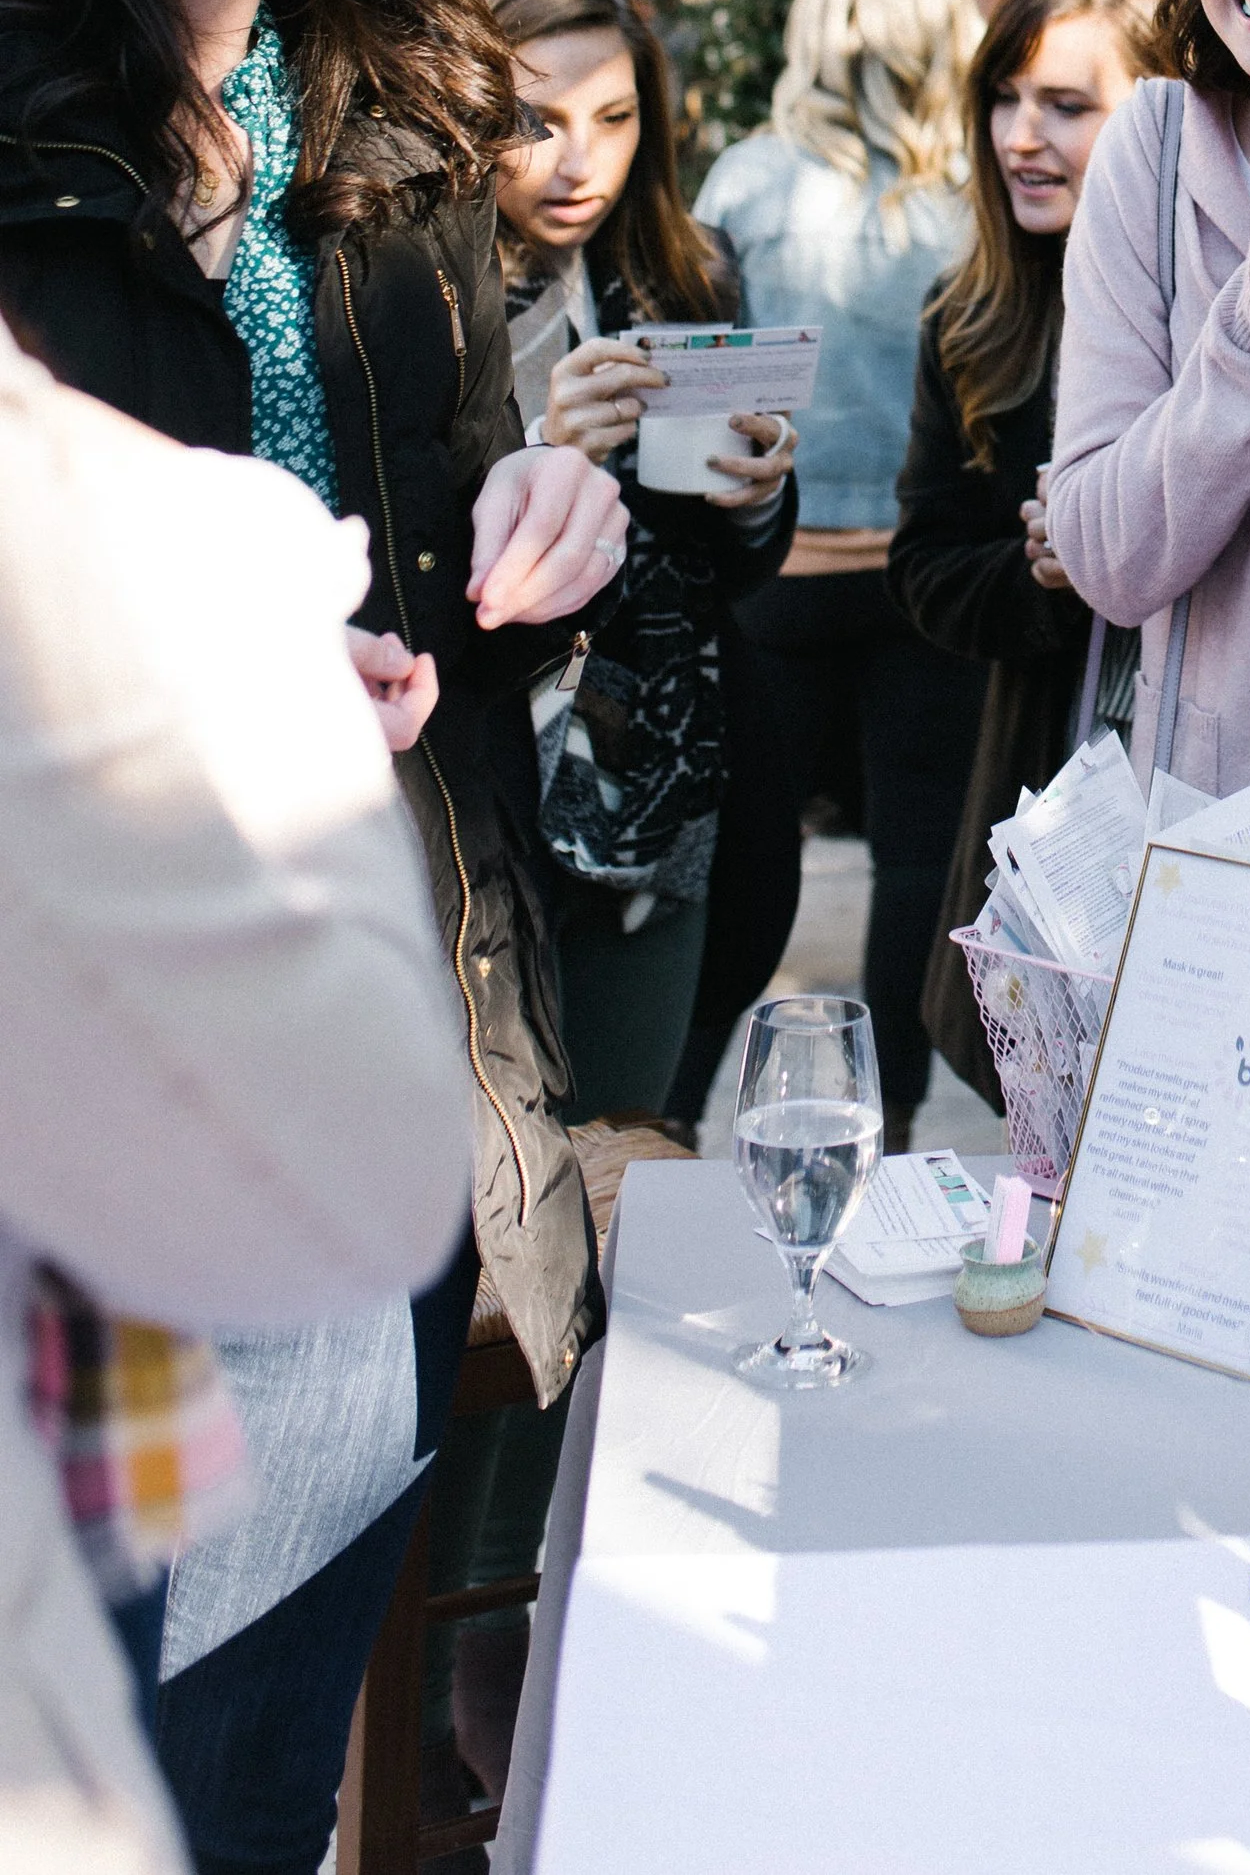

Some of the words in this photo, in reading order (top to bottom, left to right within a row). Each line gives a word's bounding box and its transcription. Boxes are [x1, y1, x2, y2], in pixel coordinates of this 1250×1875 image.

[1163, 958, 1186, 972] Mask
[1155, 1071, 1183, 1086] smells
[1119, 1080, 1148, 1095] makes
[1148, 1087, 1162, 1100] my
[1162, 1089, 1183, 1103] skin
[1183, 1094, 1201, 1110] fel
[1099, 1092, 1143, 1112] refreshed
[1185, 1115, 1212, 1133] spray
[1103, 1111, 1128, 1128] every
[1128, 1118, 1152, 1134] night
[1098, 1129, 1118, 1143] and
[1117, 1135, 1132, 1148] my
[1132, 1136, 1151, 1152] skin
[1150, 1141, 1176, 1159] looks
[1175, 1150, 1196, 1164] and
[1086, 1142, 1108, 1158] feels
[1139, 1158, 1158, 1171] also
[1158, 1162, 1179, 1178] love
[1179, 1169, 1199, 1184] that
[1106, 1166, 1119, 1179] all
[1119, 1171, 1151, 1189] natural
[1150, 1178, 1171, 1193] with
[1170, 1186, 1184, 1198] no
[1135, 1288, 1154, 1303] feel
[1154, 1293, 1171, 1310] full
[1181, 1304, 1211, 1321] good
[1201, 1288, 1223, 1303] and
